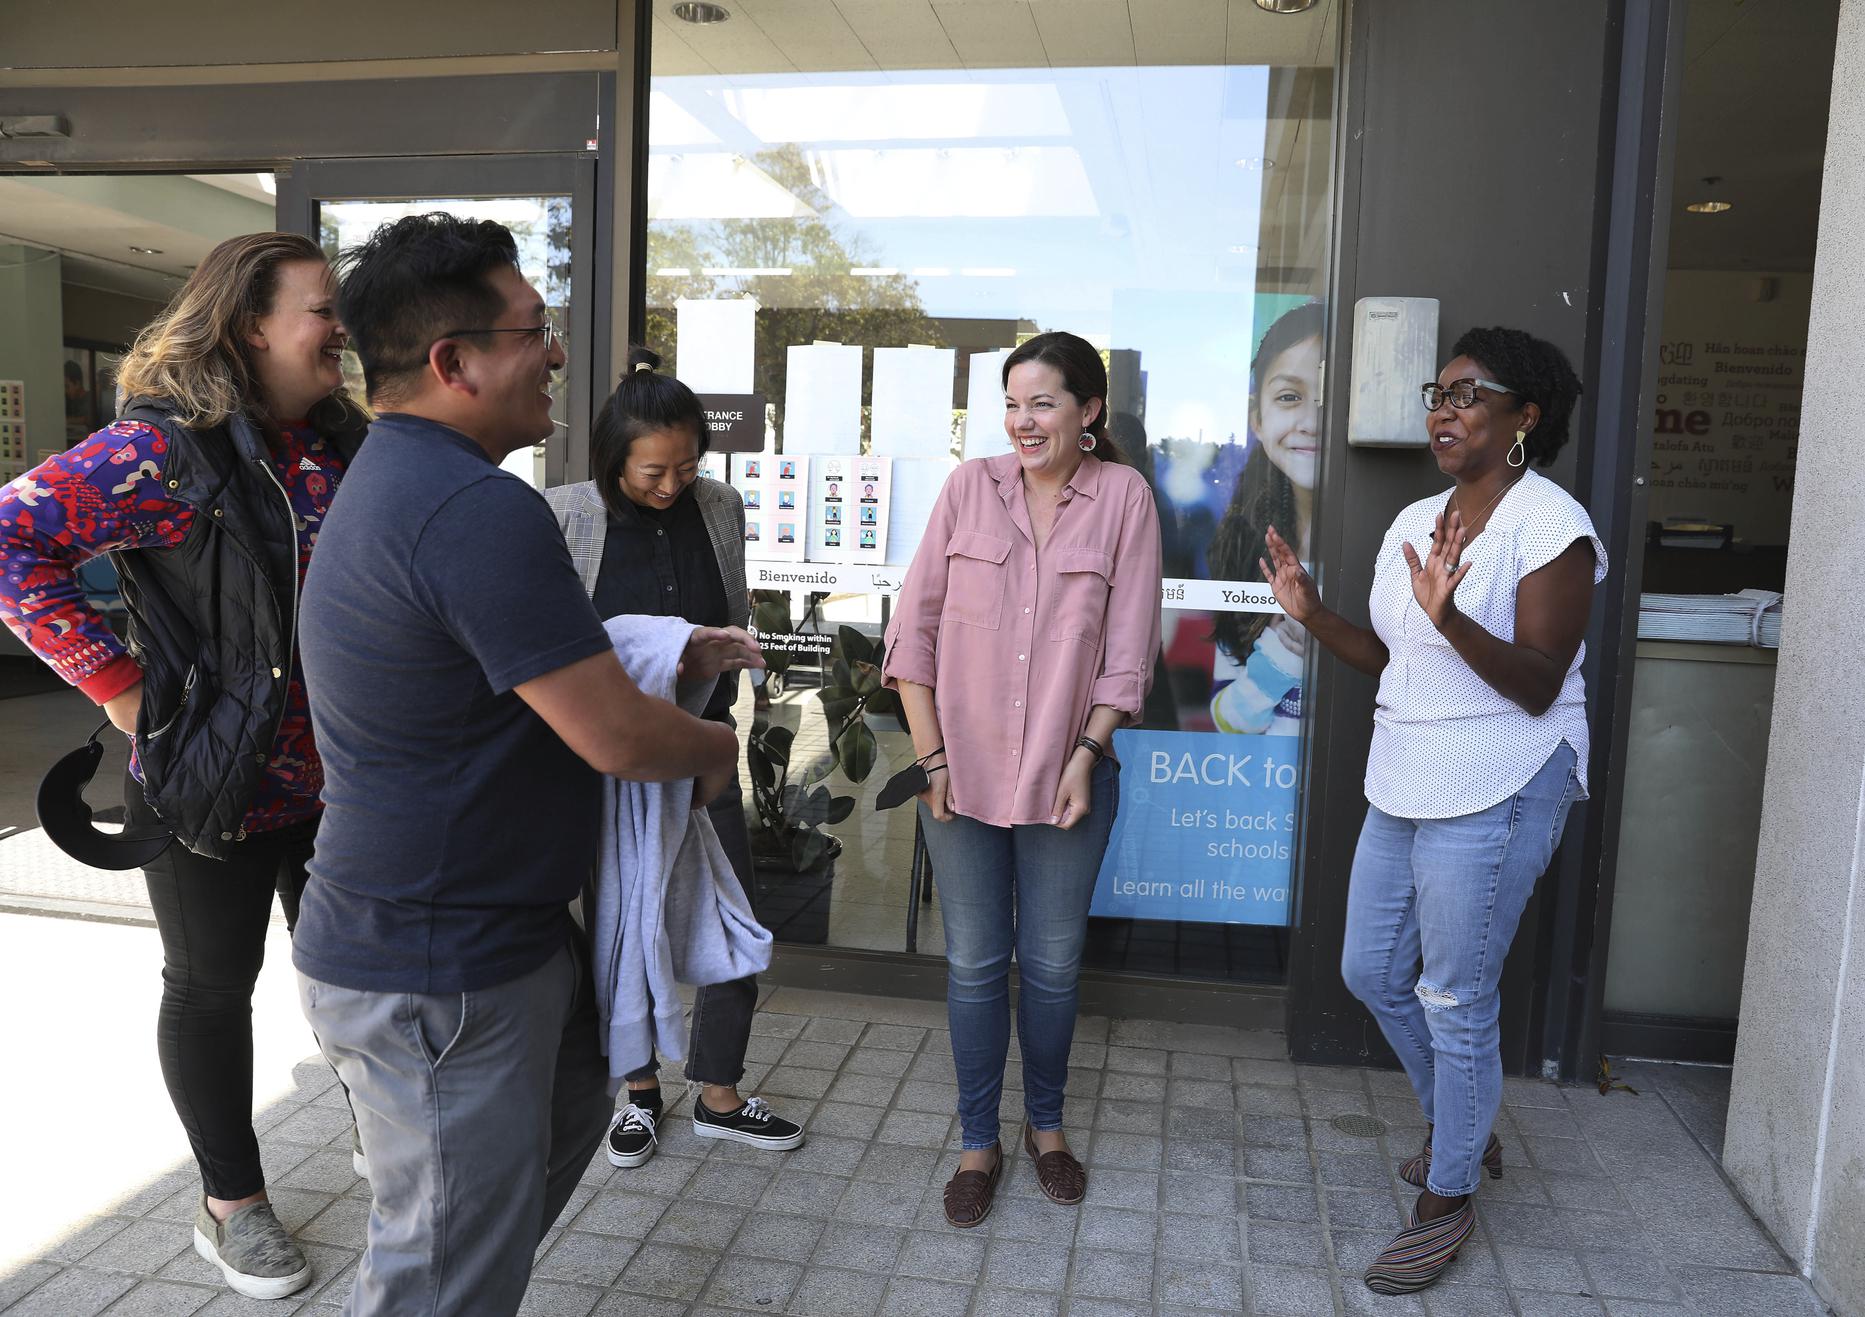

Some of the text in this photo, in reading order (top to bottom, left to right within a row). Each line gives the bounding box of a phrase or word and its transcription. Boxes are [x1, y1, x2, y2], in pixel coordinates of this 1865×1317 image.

[1714, 361, 1793, 376] Bienvenido
[759, 569, 837, 584] Bienvenido
[1222, 590, 1277, 605] Yokoso
[759, 632, 832, 644] No Smoking within
[760, 642, 831, 655] 25 Feet of Building
[1150, 751, 1297, 789] BACK to
[1226, 809, 1277, 832] back
[1207, 838, 1288, 860] schools
[1113, 876, 1172, 898] Learn
[1180, 879, 1205, 899] all
[1212, 881, 1246, 901] the
